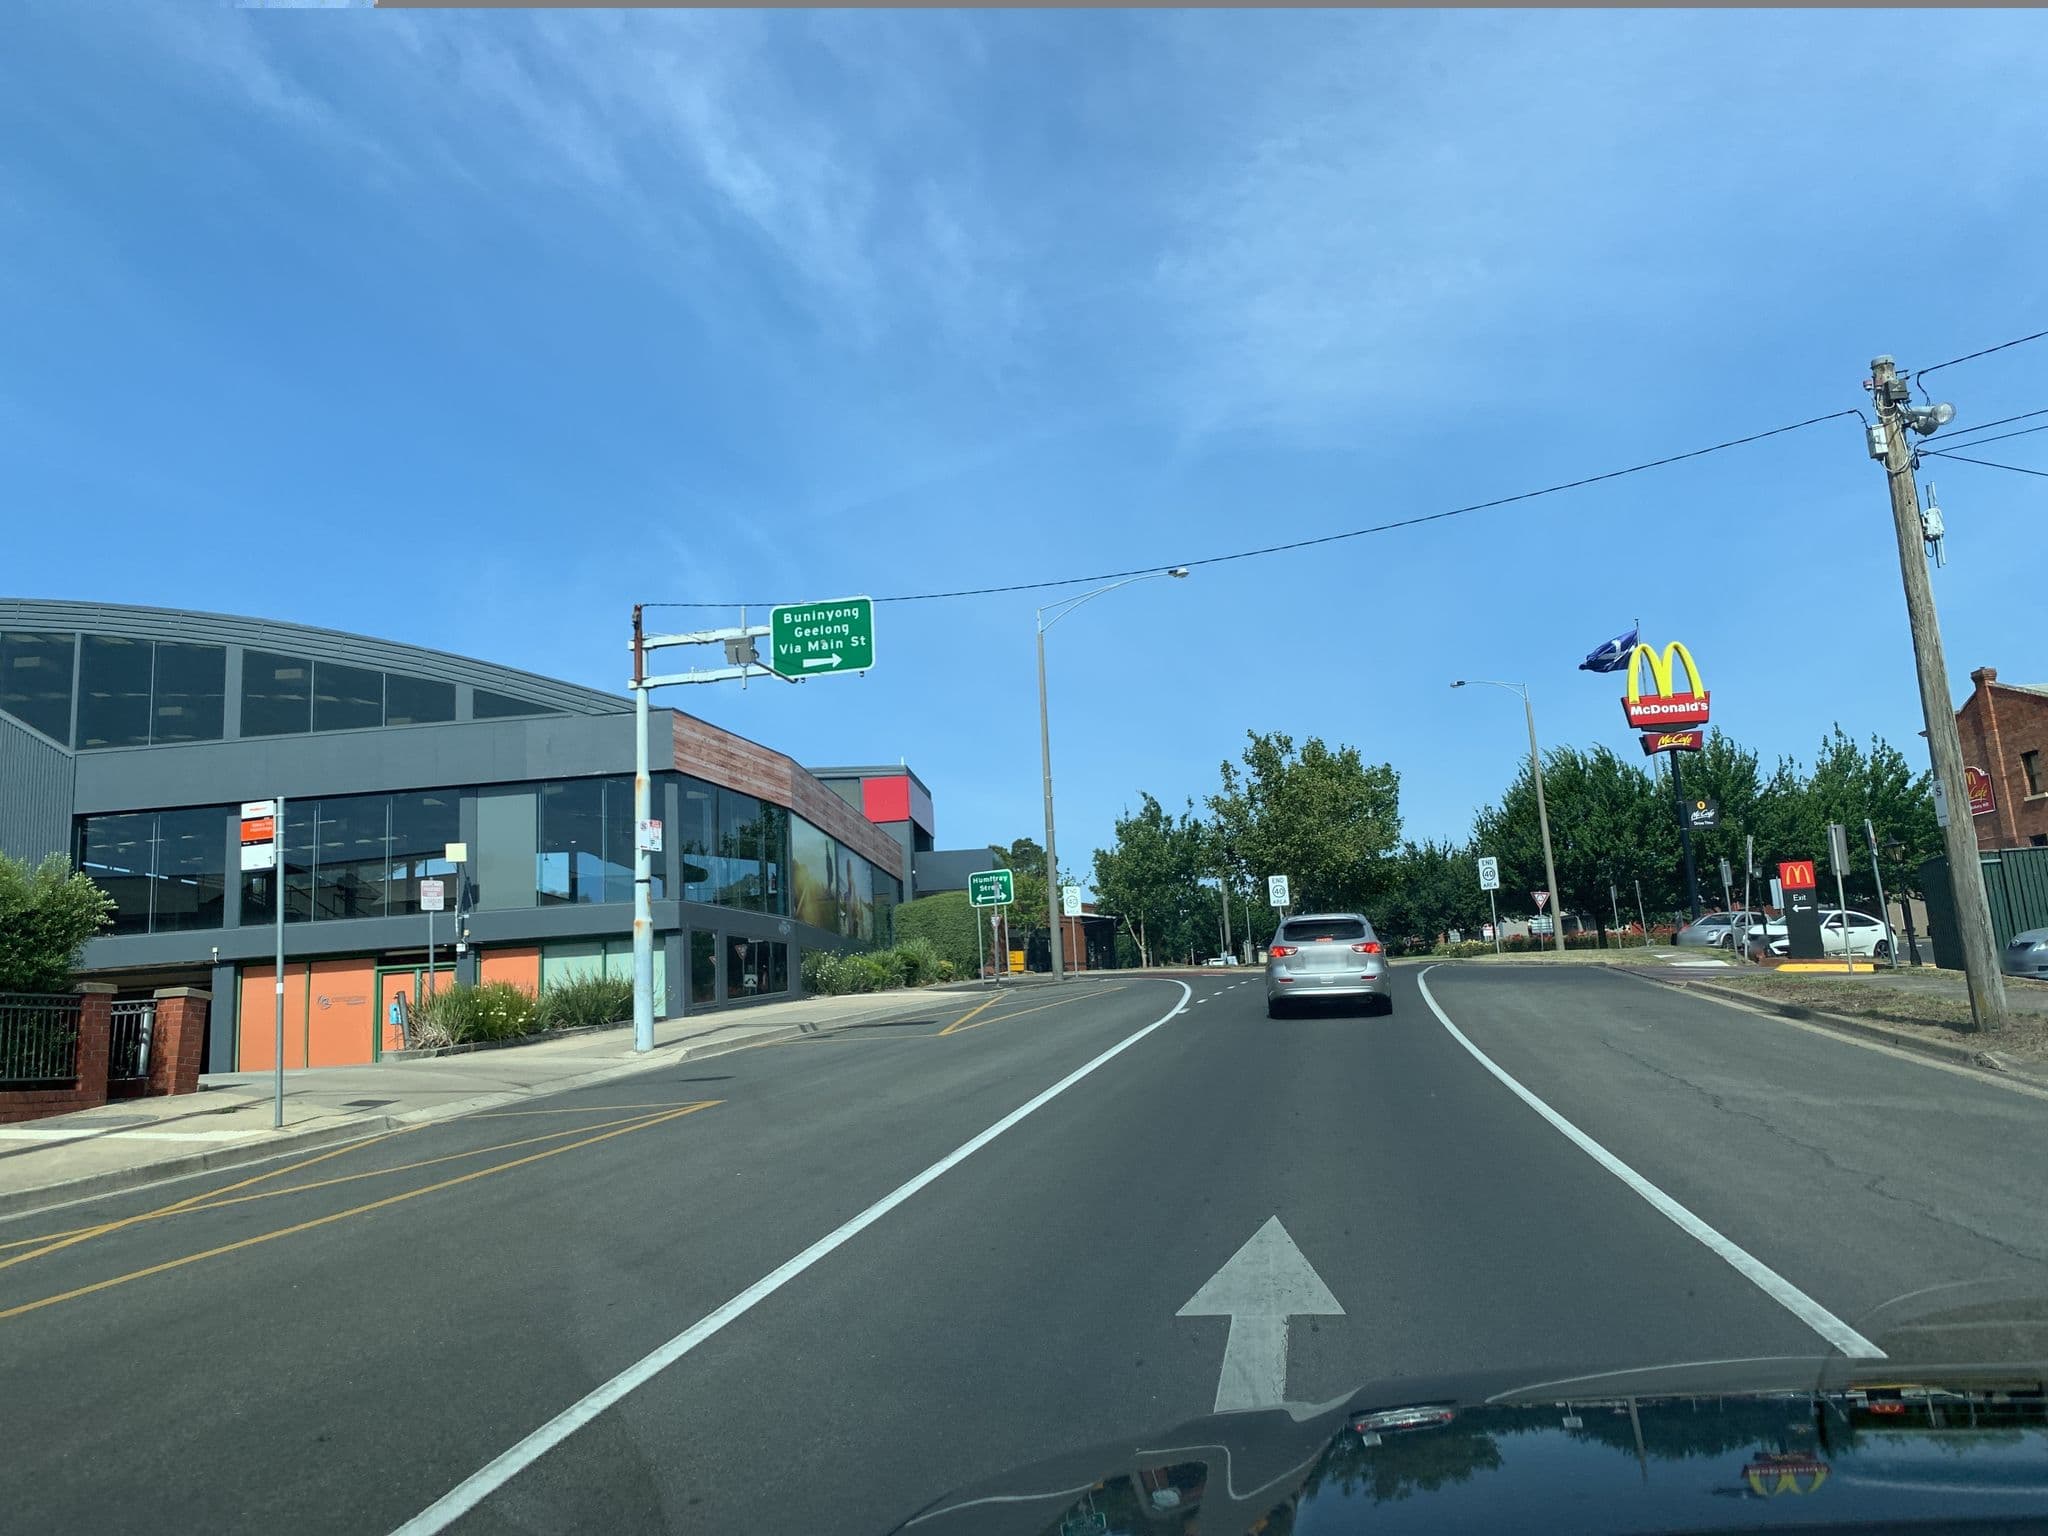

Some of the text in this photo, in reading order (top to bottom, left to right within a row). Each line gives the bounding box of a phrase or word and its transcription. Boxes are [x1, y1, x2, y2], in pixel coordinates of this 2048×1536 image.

[783, 607, 859, 624] Buninyong
[794, 624, 849, 638] Geelong
[779, 636, 866, 655] Via Main St
[1630, 702, 1708, 715] McDonald's
[1793, 893, 1806, 901] Exit
